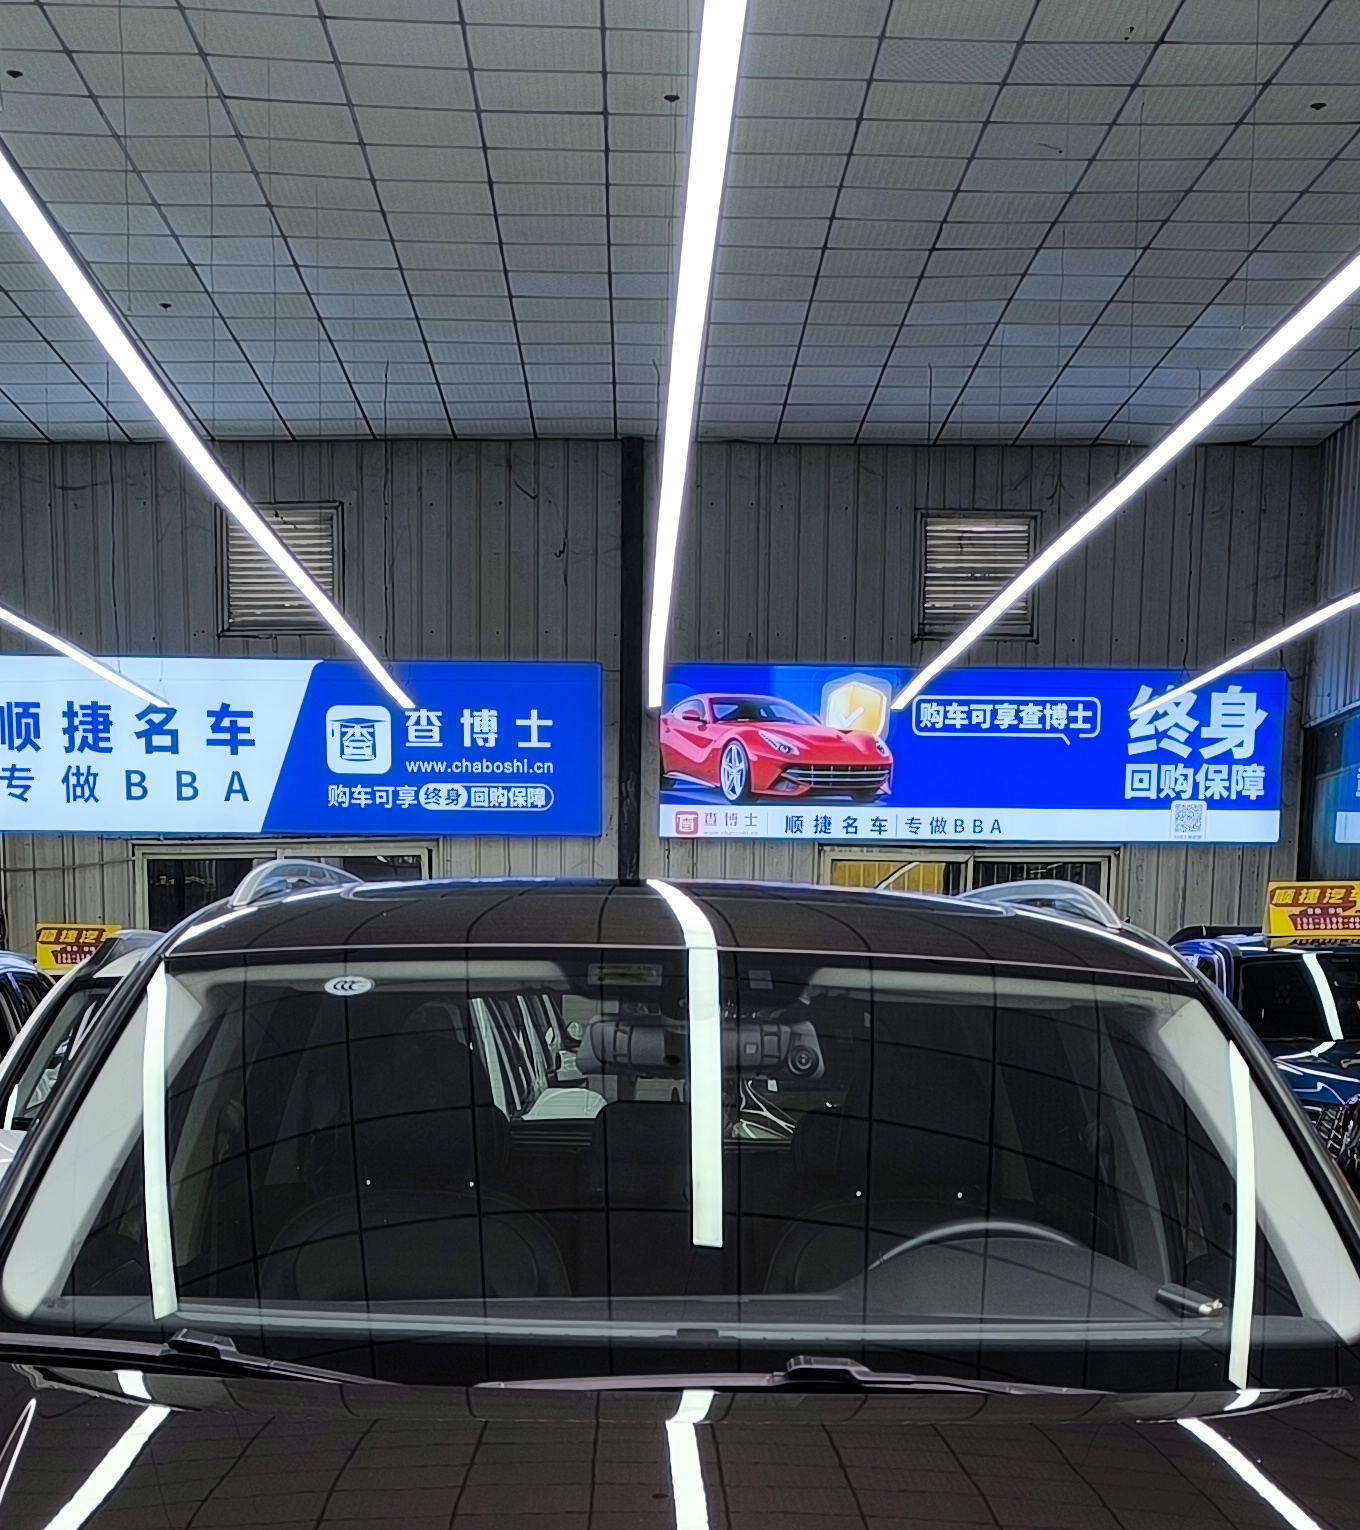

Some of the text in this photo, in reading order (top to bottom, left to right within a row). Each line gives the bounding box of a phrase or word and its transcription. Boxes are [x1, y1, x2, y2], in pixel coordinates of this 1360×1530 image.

[404, 708, 554, 750] 查博士
[919, 701, 1094, 731] 购车可享查博士
[1127, 684, 1269, 760] 终身
[405, 757, 555, 776] www.chaboshi.cn
[1123, 762, 1268, 801] 回购保障
[703, 811, 759, 829] 查博士
[785, 814, 889, 836] 顺捷名车
